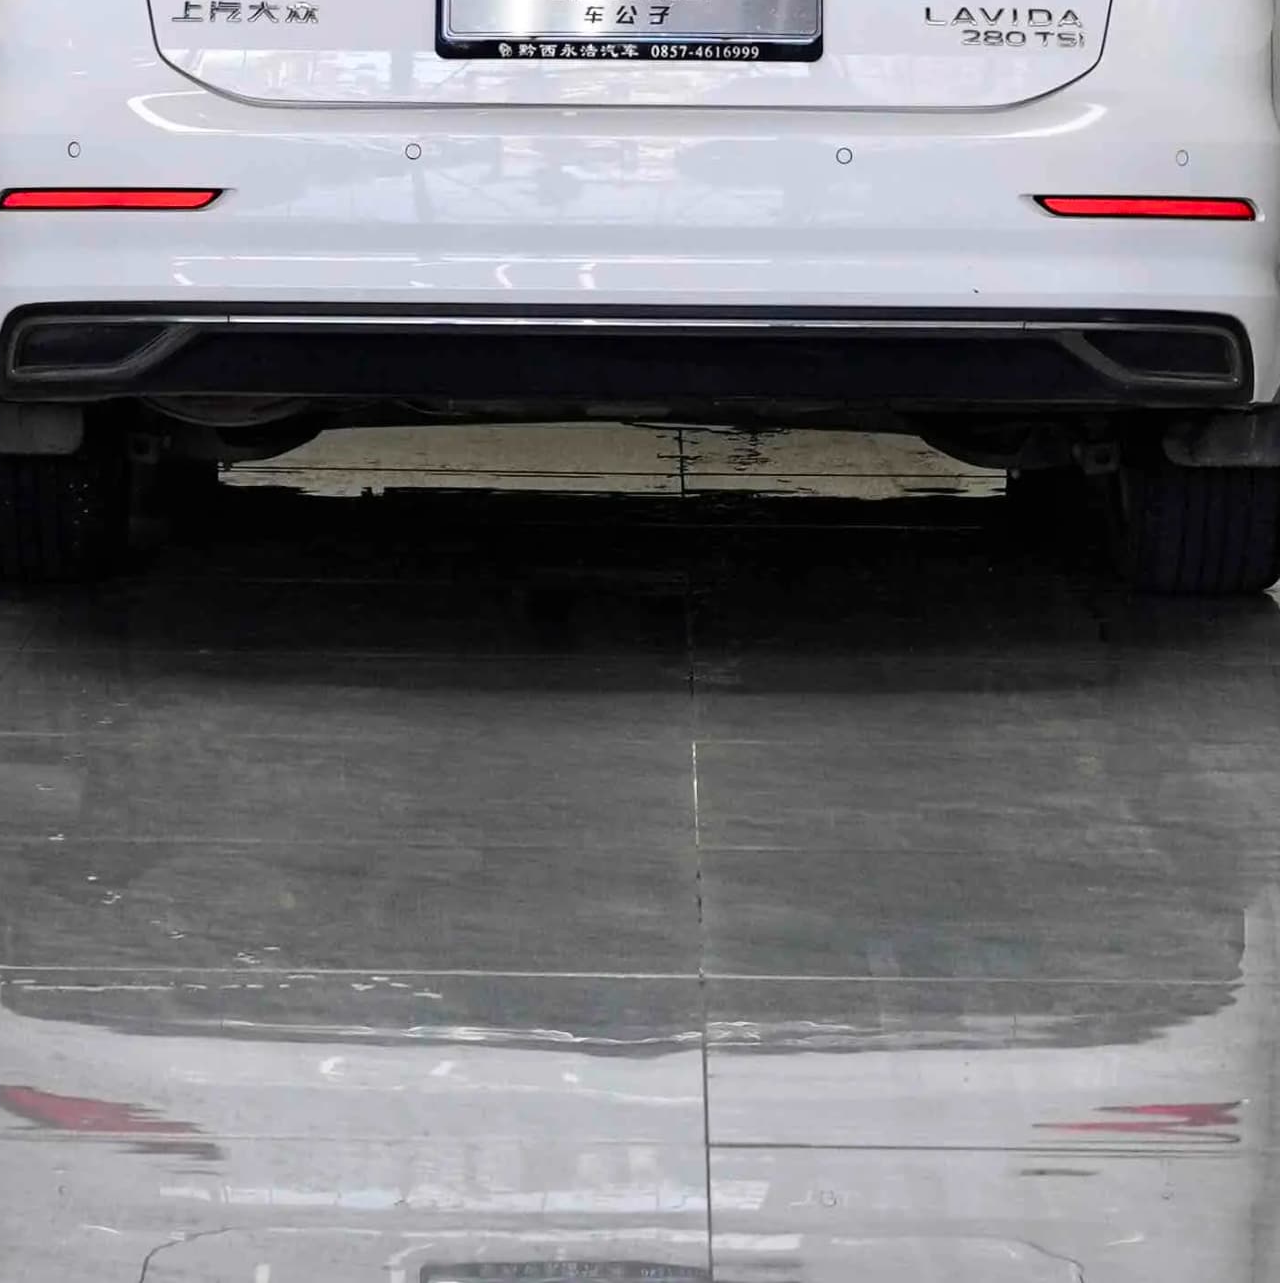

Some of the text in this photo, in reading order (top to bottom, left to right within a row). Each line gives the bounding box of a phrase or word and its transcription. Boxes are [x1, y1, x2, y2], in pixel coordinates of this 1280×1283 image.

[172, 0, 320, 24] 上汽大众
[584, 5, 673, 26] 车公子
[924, 6, 1083, 28] LAVIDA
[650, 44, 760, 60] 0857-4616999
